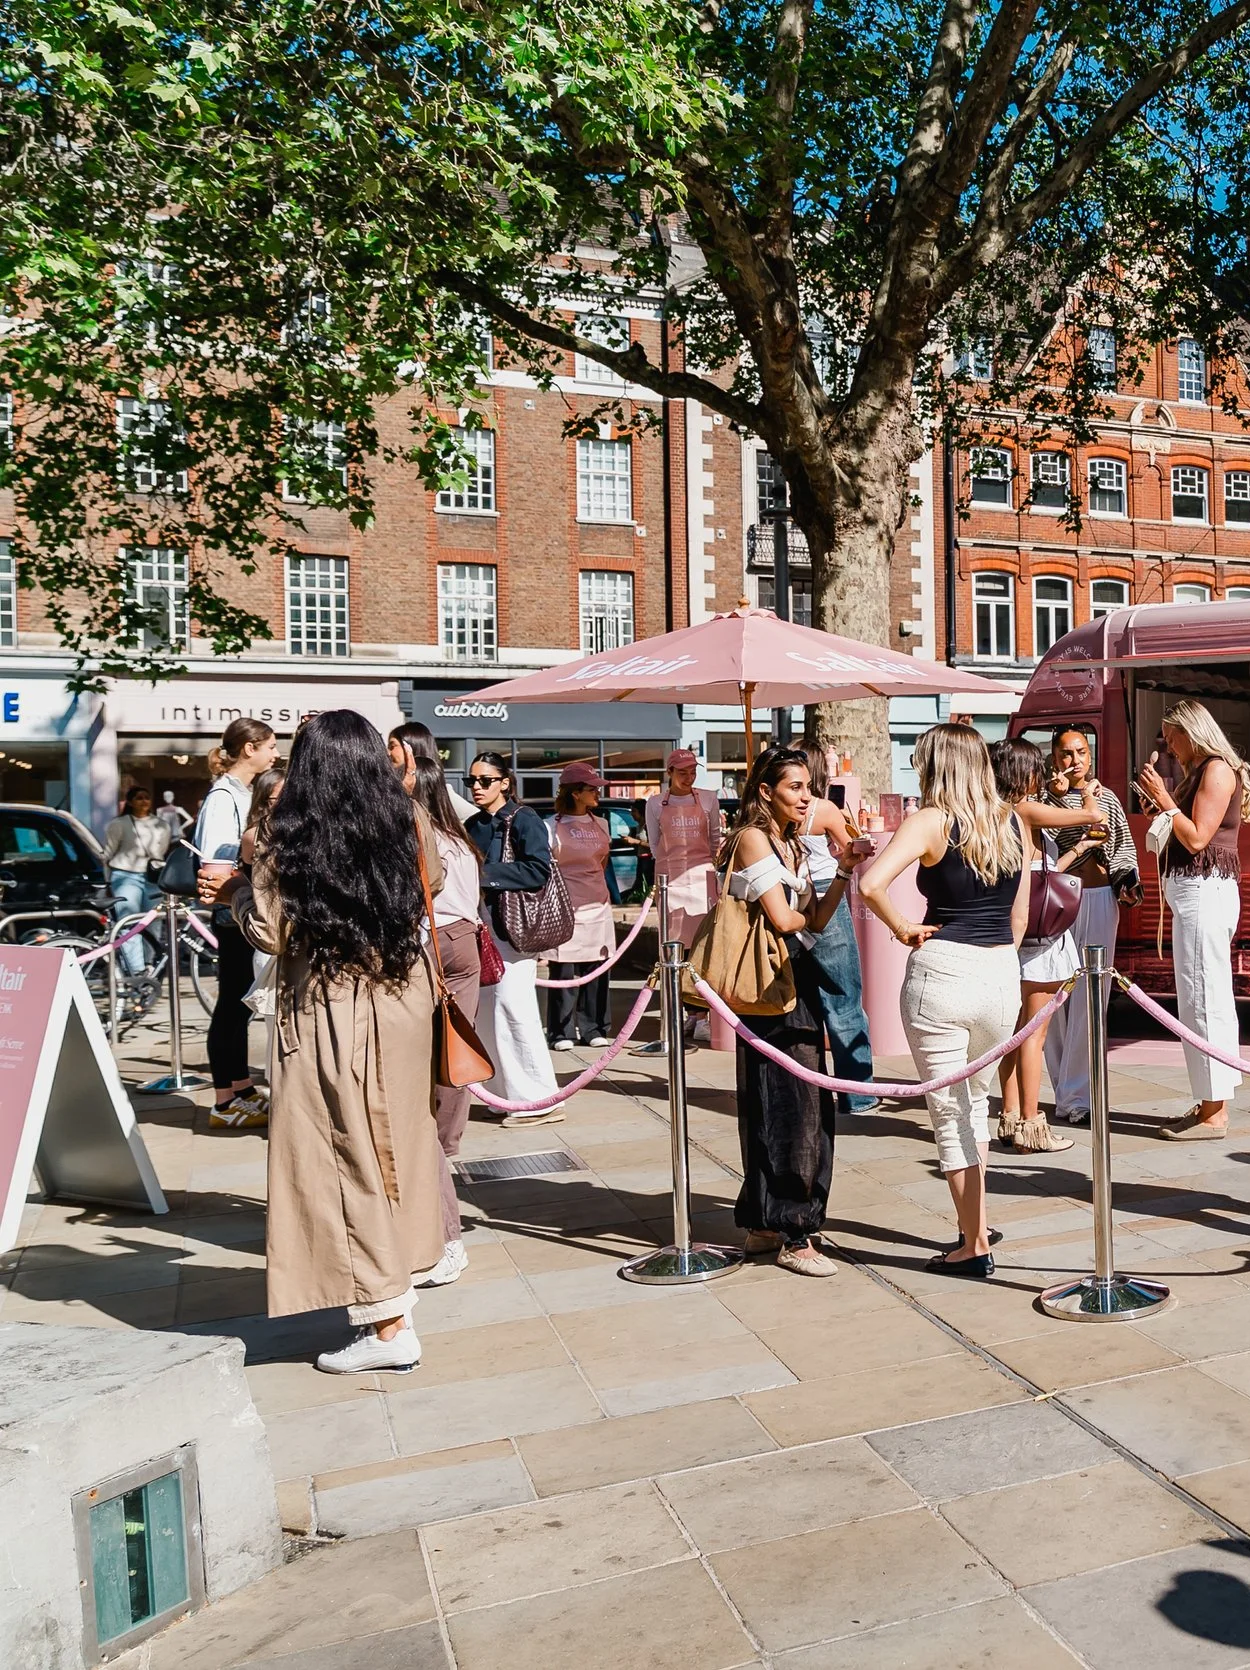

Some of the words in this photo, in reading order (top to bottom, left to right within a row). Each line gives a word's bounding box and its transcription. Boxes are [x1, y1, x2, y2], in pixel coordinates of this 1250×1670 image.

[556, 655, 698, 682] Saltair
[785, 651, 928, 677] Saltair
[162, 705, 326, 721] intimissi
